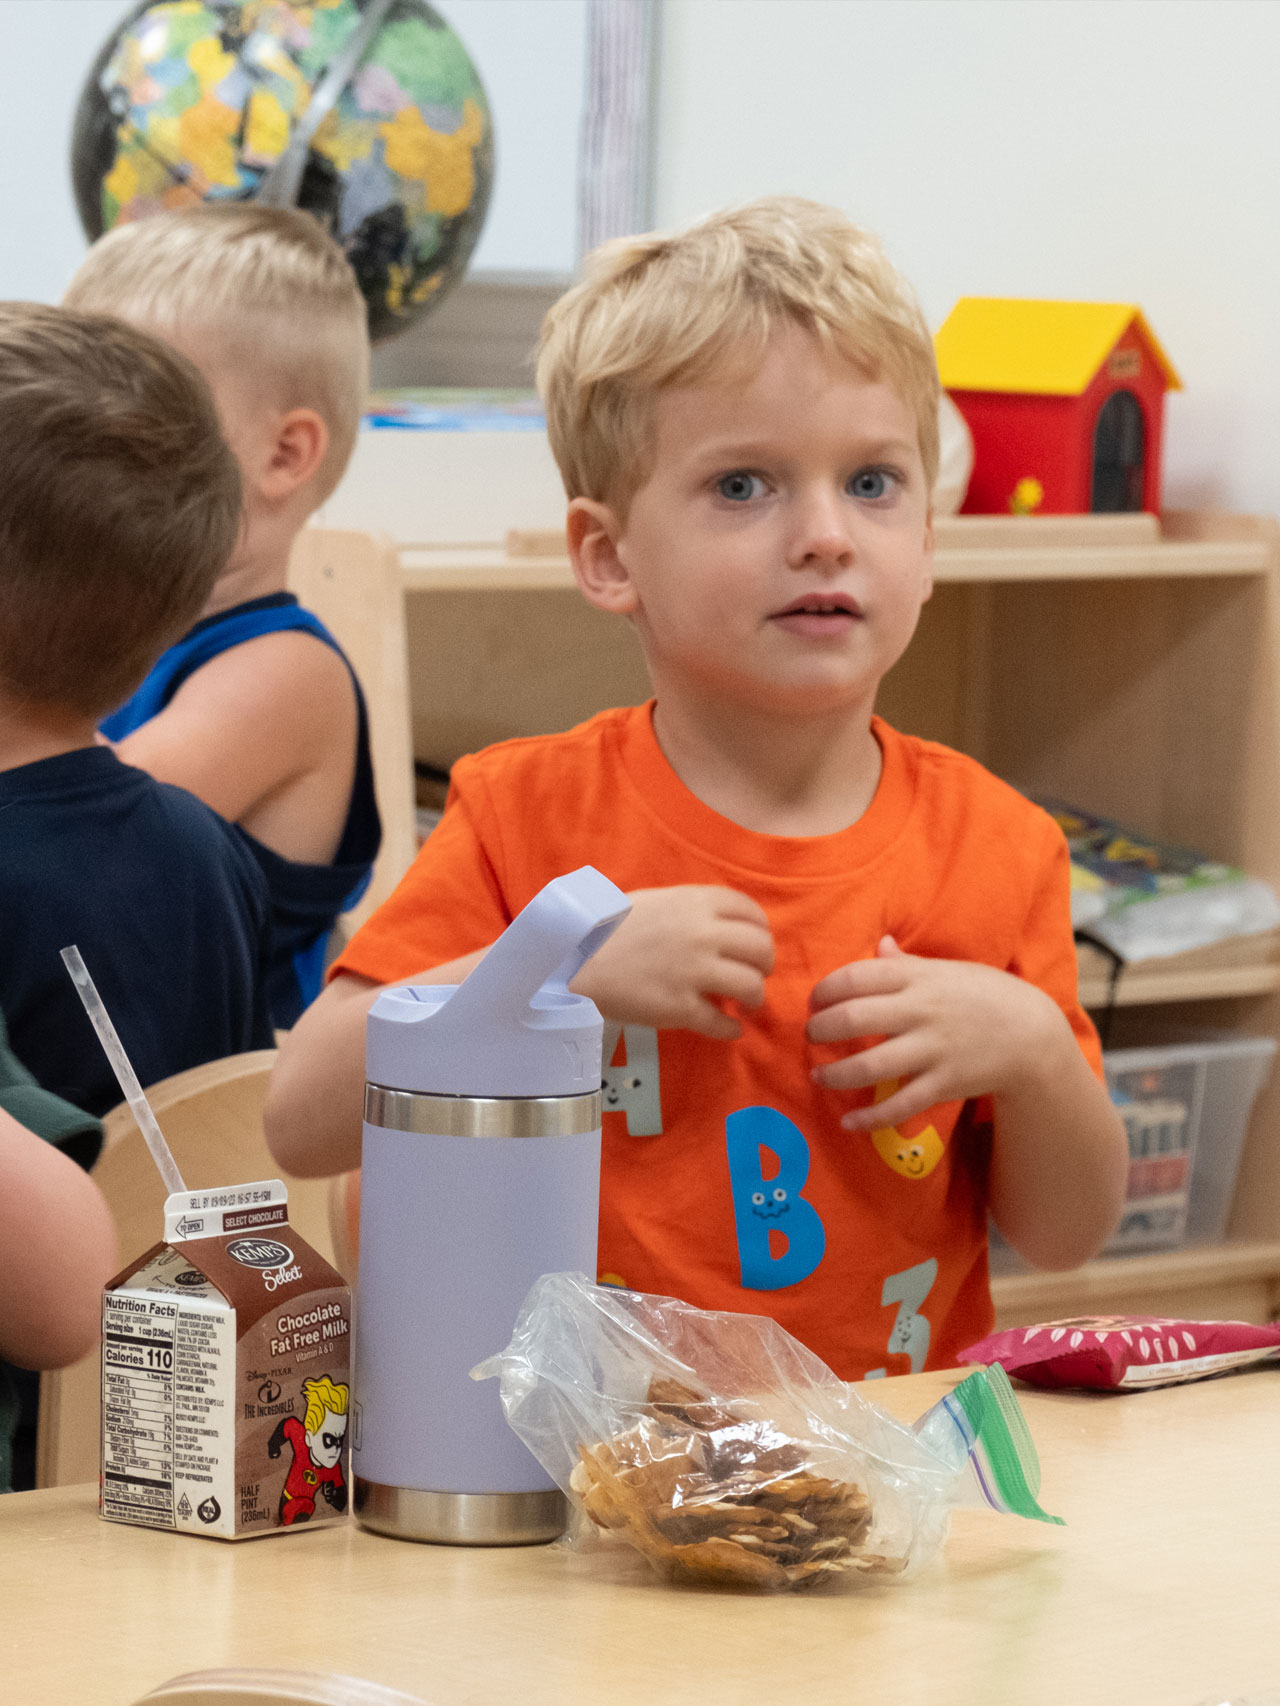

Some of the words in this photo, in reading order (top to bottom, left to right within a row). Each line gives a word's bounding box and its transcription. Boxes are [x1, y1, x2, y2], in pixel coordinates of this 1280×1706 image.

[600, 1024, 663, 1137] A
[725, 1105, 826, 1291] B
[190, 1198, 201, 1209] SELL
[187, 1223, 201, 1231] OPEN
[225, 1215, 247, 1228] SELECT
[248, 1210, 284, 1223] CHOCOLATE
[230, 1244, 285, 1262] KEMPS
[262, 1265, 303, 1292] Select
[106, 1296, 146, 1312] Nutrition
[149, 1302, 176, 1316] Facts
[109, 1312, 124, 1323] serving
[132, 1316, 152, 1325] container
[278, 1304, 341, 1333] Chocolate
[106, 1321, 123, 1333] Serving
[124, 1324, 134, 1333] size
[142, 1329, 152, 1337] cup
[271, 1337, 291, 1355] Fat
[293, 1330, 320, 1349] Free
[322, 1319, 348, 1340] Milk
[128, 1346, 143, 1354] serving
[295, 1348, 318, 1363] Vitamin
[318, 1346, 323, 1355] A
[106, 1349, 144, 1365] Calories
[147, 1349, 172, 1369] 110
[106, 1374, 117, 1382] Total
[106, 1405, 130, 1415] Cholesterol
[245, 1403, 255, 1419] THE
[106, 1423, 116, 1432] Total
[117, 1425, 147, 1437] Carbohydrate
[106, 1462, 121, 1471] Protein
[240, 1485, 260, 1498] HALF
[241, 1497, 258, 1510] PINT
[241, 1508, 270, 1525] (236mL)
